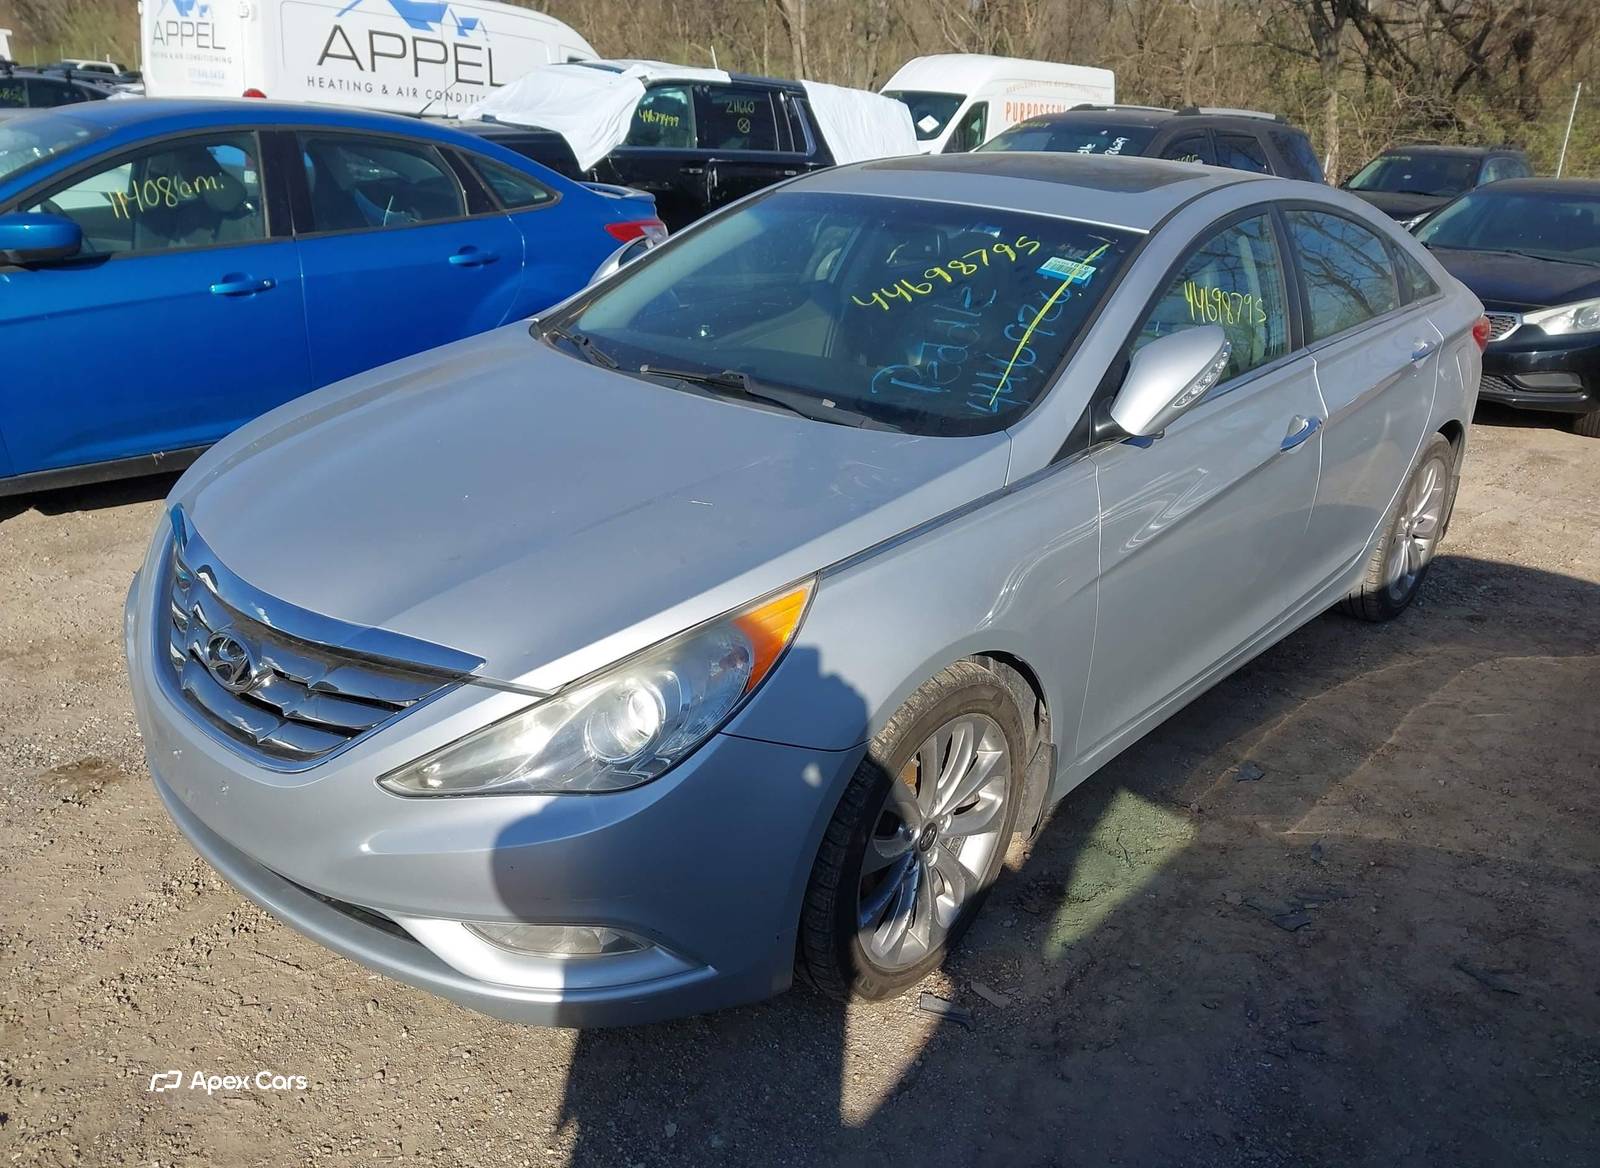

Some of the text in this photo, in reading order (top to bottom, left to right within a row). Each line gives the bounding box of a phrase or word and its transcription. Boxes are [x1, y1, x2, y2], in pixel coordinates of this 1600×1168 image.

[152, 20, 226, 50] APPEL
[316, 24, 507, 87] APPEL
[307, 76, 374, 93] HEATING
[381, 84, 389, 95] &
[396, 87, 418, 98] AIR
[1183, 281, 1268, 325] 44698795
